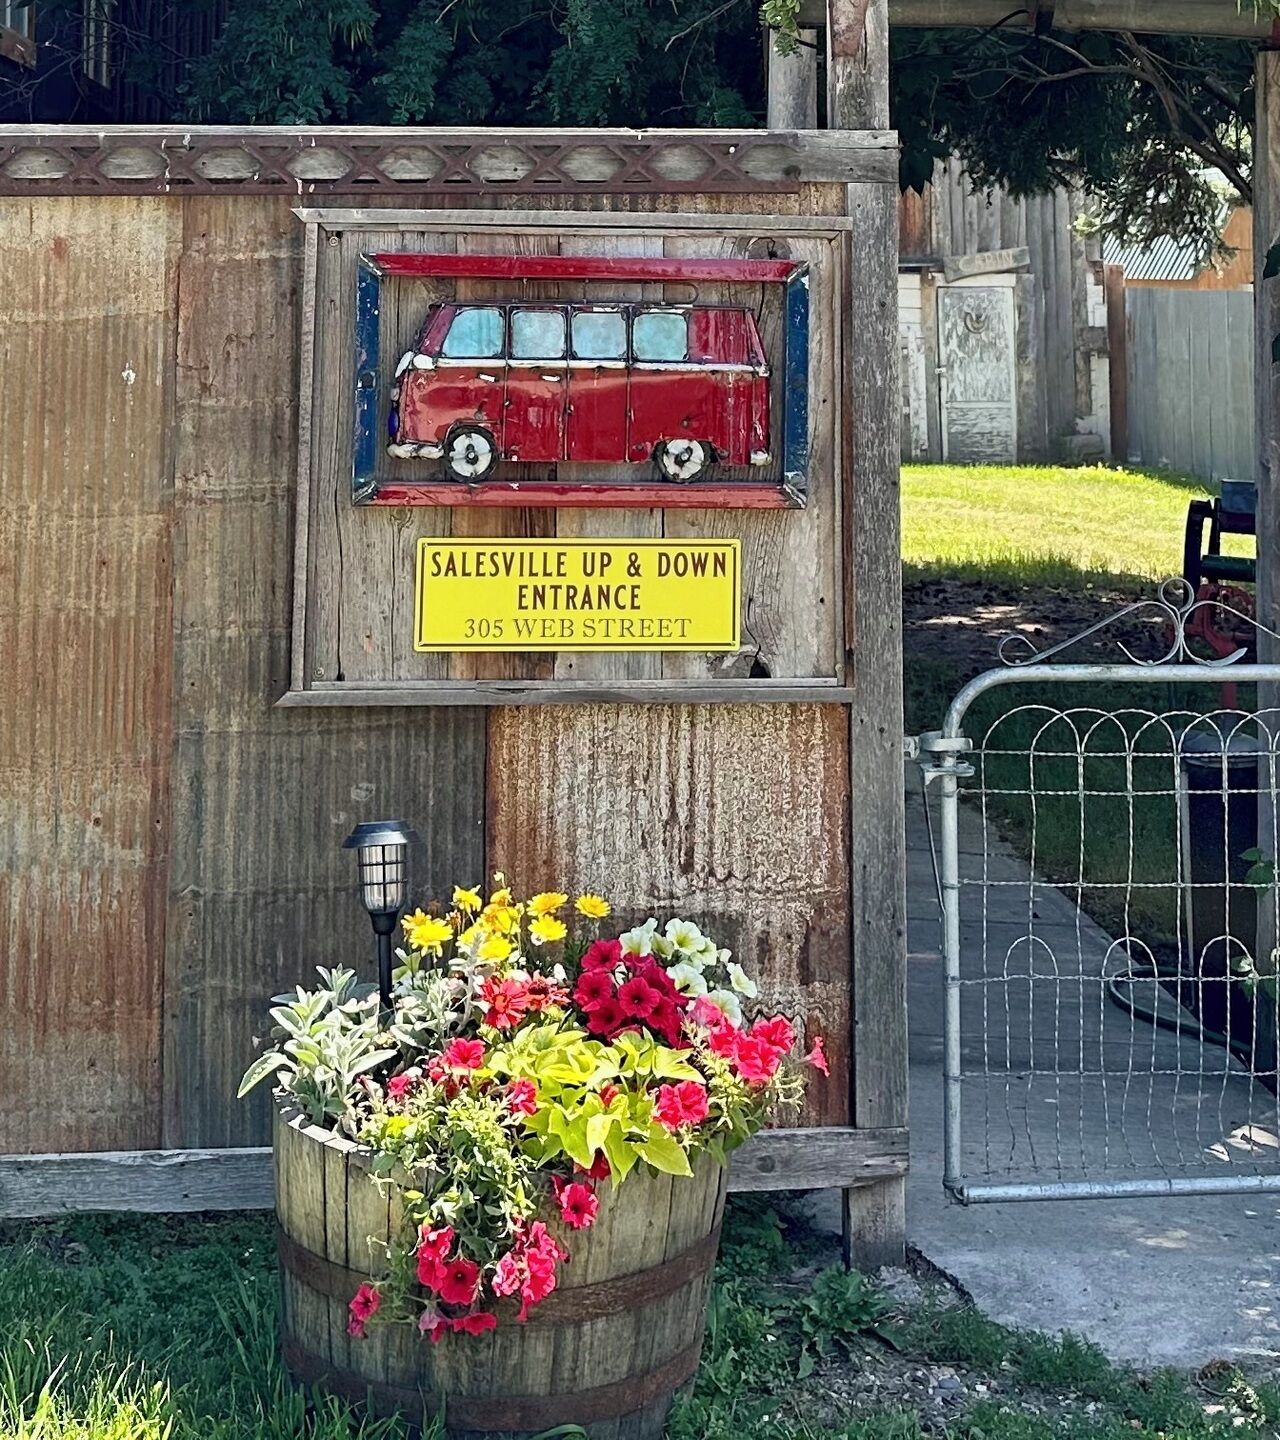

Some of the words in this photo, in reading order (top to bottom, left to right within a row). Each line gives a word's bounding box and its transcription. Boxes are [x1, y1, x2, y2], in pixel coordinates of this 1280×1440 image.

[431, 551, 567, 578] SALESVILLE
[582, 551, 612, 578] UP
[626, 551, 643, 578] &
[657, 551, 727, 578] DOWN
[517, 584, 642, 610] ENTRANCE
[464, 618, 504, 639] 305
[513, 618, 574, 639] WEB
[582, 618, 692, 639] STREET
